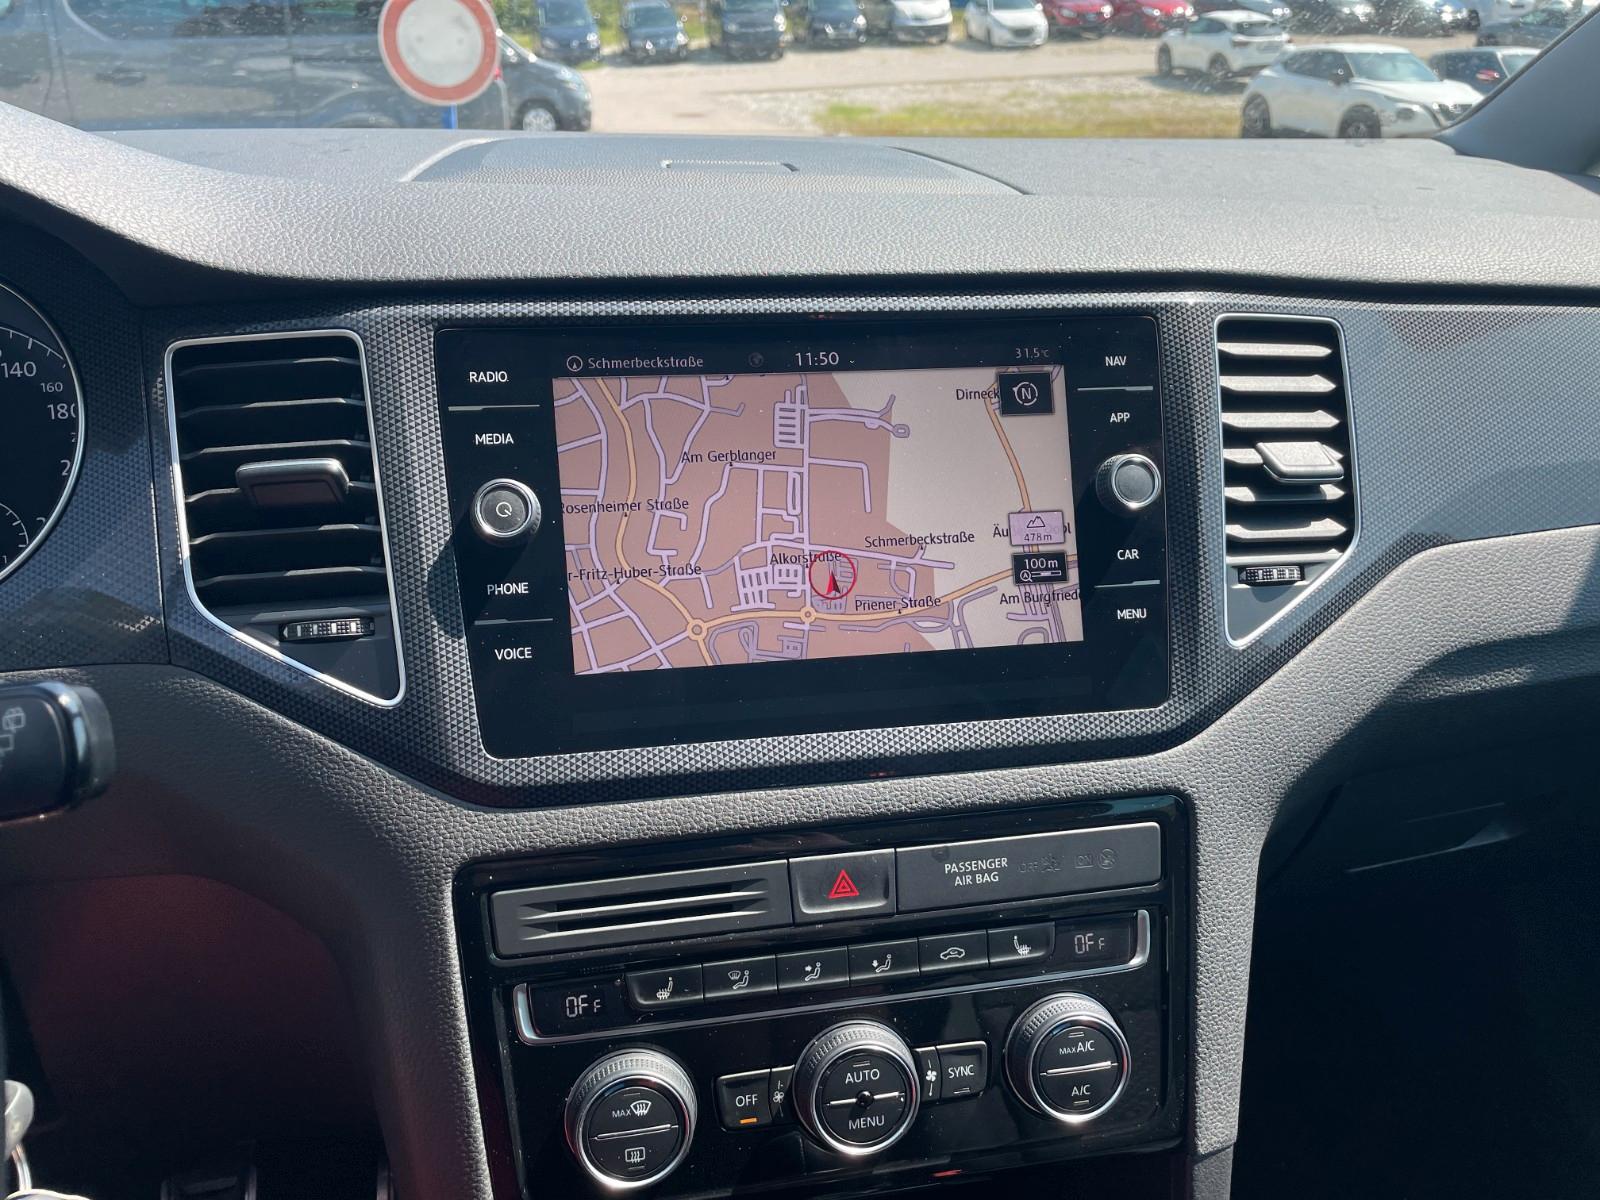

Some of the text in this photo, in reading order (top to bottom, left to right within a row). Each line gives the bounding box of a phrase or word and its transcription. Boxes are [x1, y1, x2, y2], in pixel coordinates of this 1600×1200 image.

[588, 356, 705, 370] Schmerbeckstraße
[795, 352, 839, 366] 11:50
[1105, 355, 1127, 367] NAV
[0, 361, 37, 378] 140
[469, 371, 508, 383] RADIO
[40, 381, 63, 393] 160
[1109, 412, 1130, 423] APP
[475, 433, 514, 445] MEDIA
[681, 449, 777, 464] Am Gerblanger
[646, 498, 689, 511] Straße
[864, 530, 975, 549] Schmerbeckstraße
[1117, 548, 1139, 560] CAR
[487, 582, 529, 596] PHONE
[855, 596, 941, 612] Priener Straße
[1000, 592, 1020, 605] Am
[1117, 608, 1147, 620] MENU
[494, 646, 532, 661] VOICE
[944, 857, 1008, 874] PASSENGER
[954, 871, 999, 886] AIR BAG
[1075, 1039, 1095, 1054] A/C
[845, 1068, 880, 1085] AUTO
[948, 1064, 975, 1080] SYNC
[1071, 1083, 1091, 1097] A/C
[735, 1094, 758, 1107] OFF
[612, 1108, 631, 1119] MAX
[848, 1114, 885, 1130] MENU
